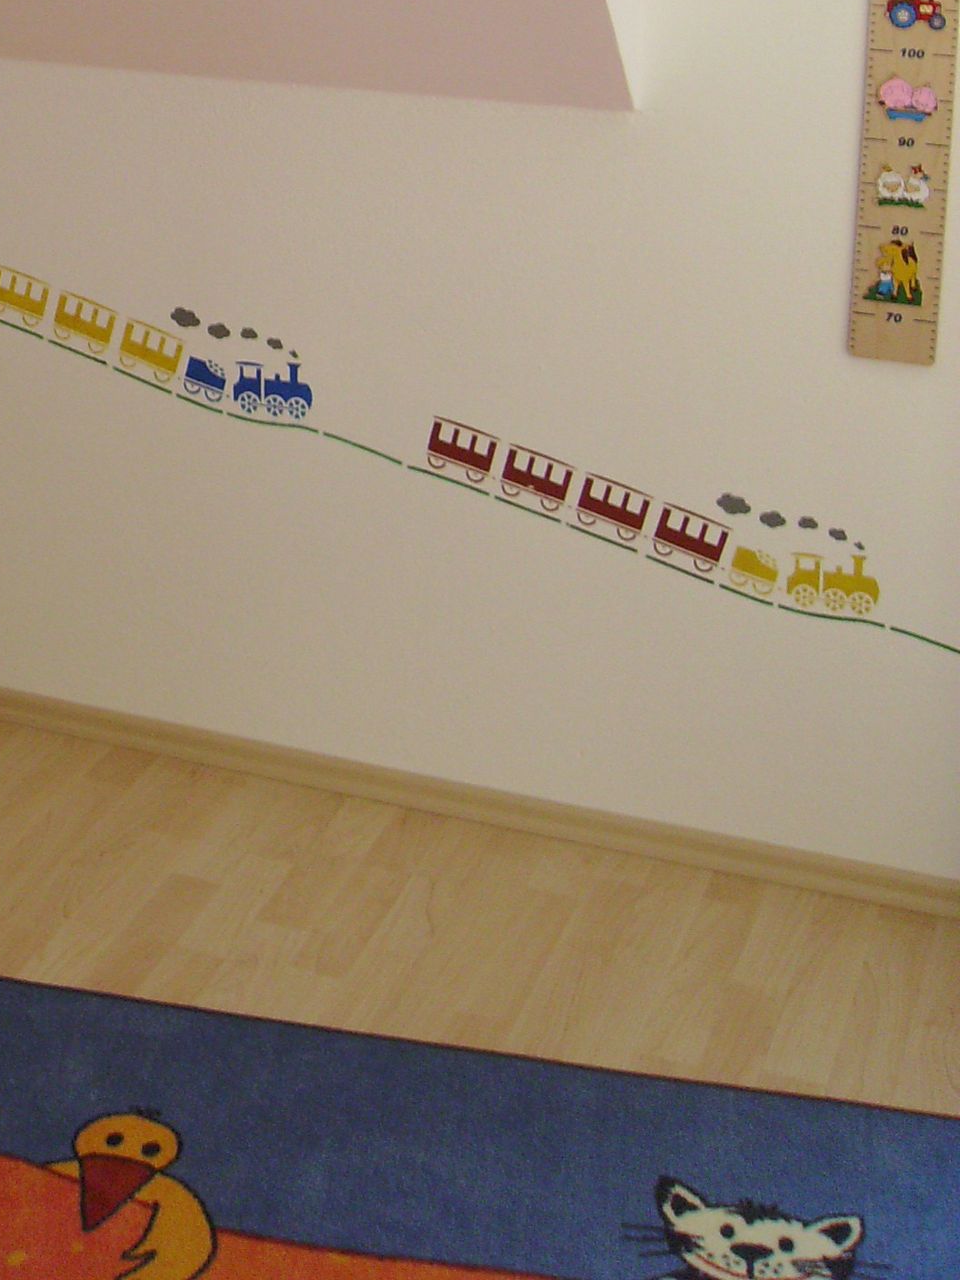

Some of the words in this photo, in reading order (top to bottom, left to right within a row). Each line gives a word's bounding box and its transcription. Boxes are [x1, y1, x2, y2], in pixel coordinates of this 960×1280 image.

[900, 48, 925, 59] 100
[898, 137, 915, 147] 90
[891, 224, 909, 236] 80
[886, 312, 903, 323] 70
